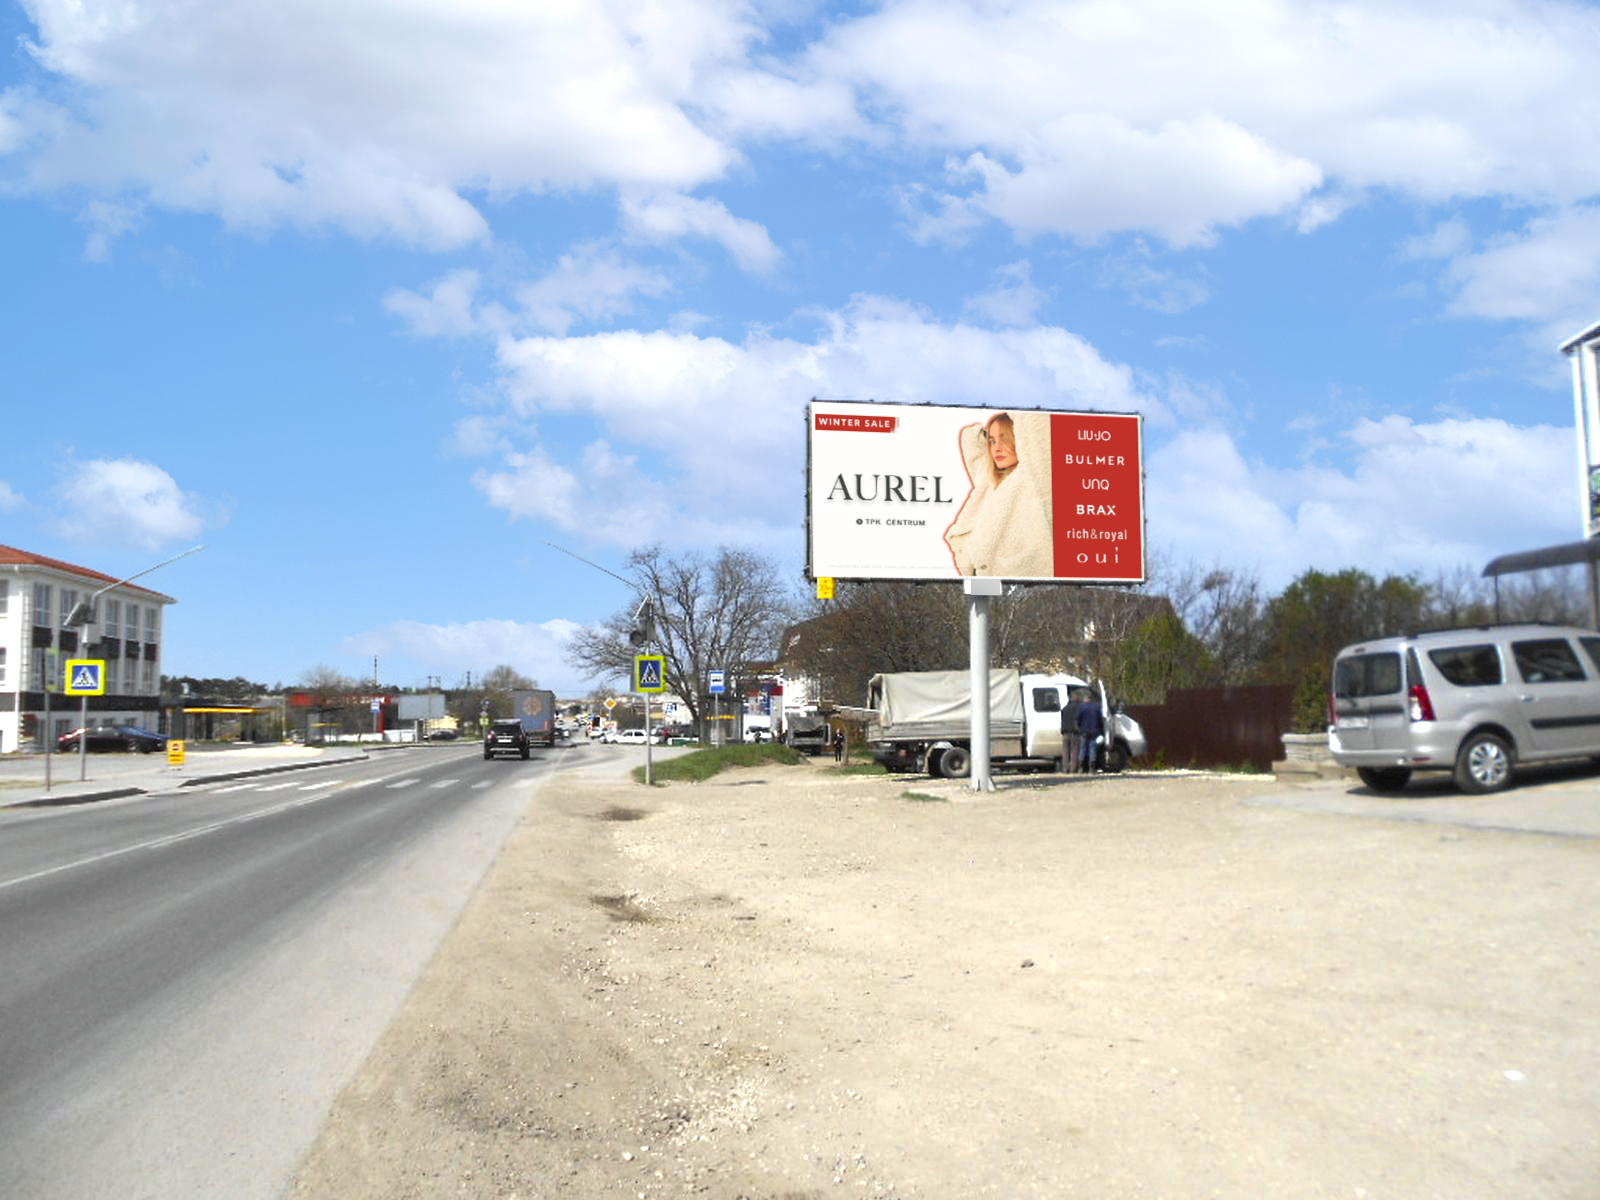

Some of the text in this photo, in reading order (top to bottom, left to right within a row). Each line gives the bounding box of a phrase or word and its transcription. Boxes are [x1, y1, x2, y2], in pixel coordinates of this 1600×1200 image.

[818, 417, 890, 428] WINTER SALE
[1065, 454, 1125, 466] BULMER
[826, 473, 953, 503] AUREL
[1076, 504, 1116, 516] BRAX
[865, 518, 926, 527] TPK CENTRUM
[1066, 528, 1127, 542] rich&royal
